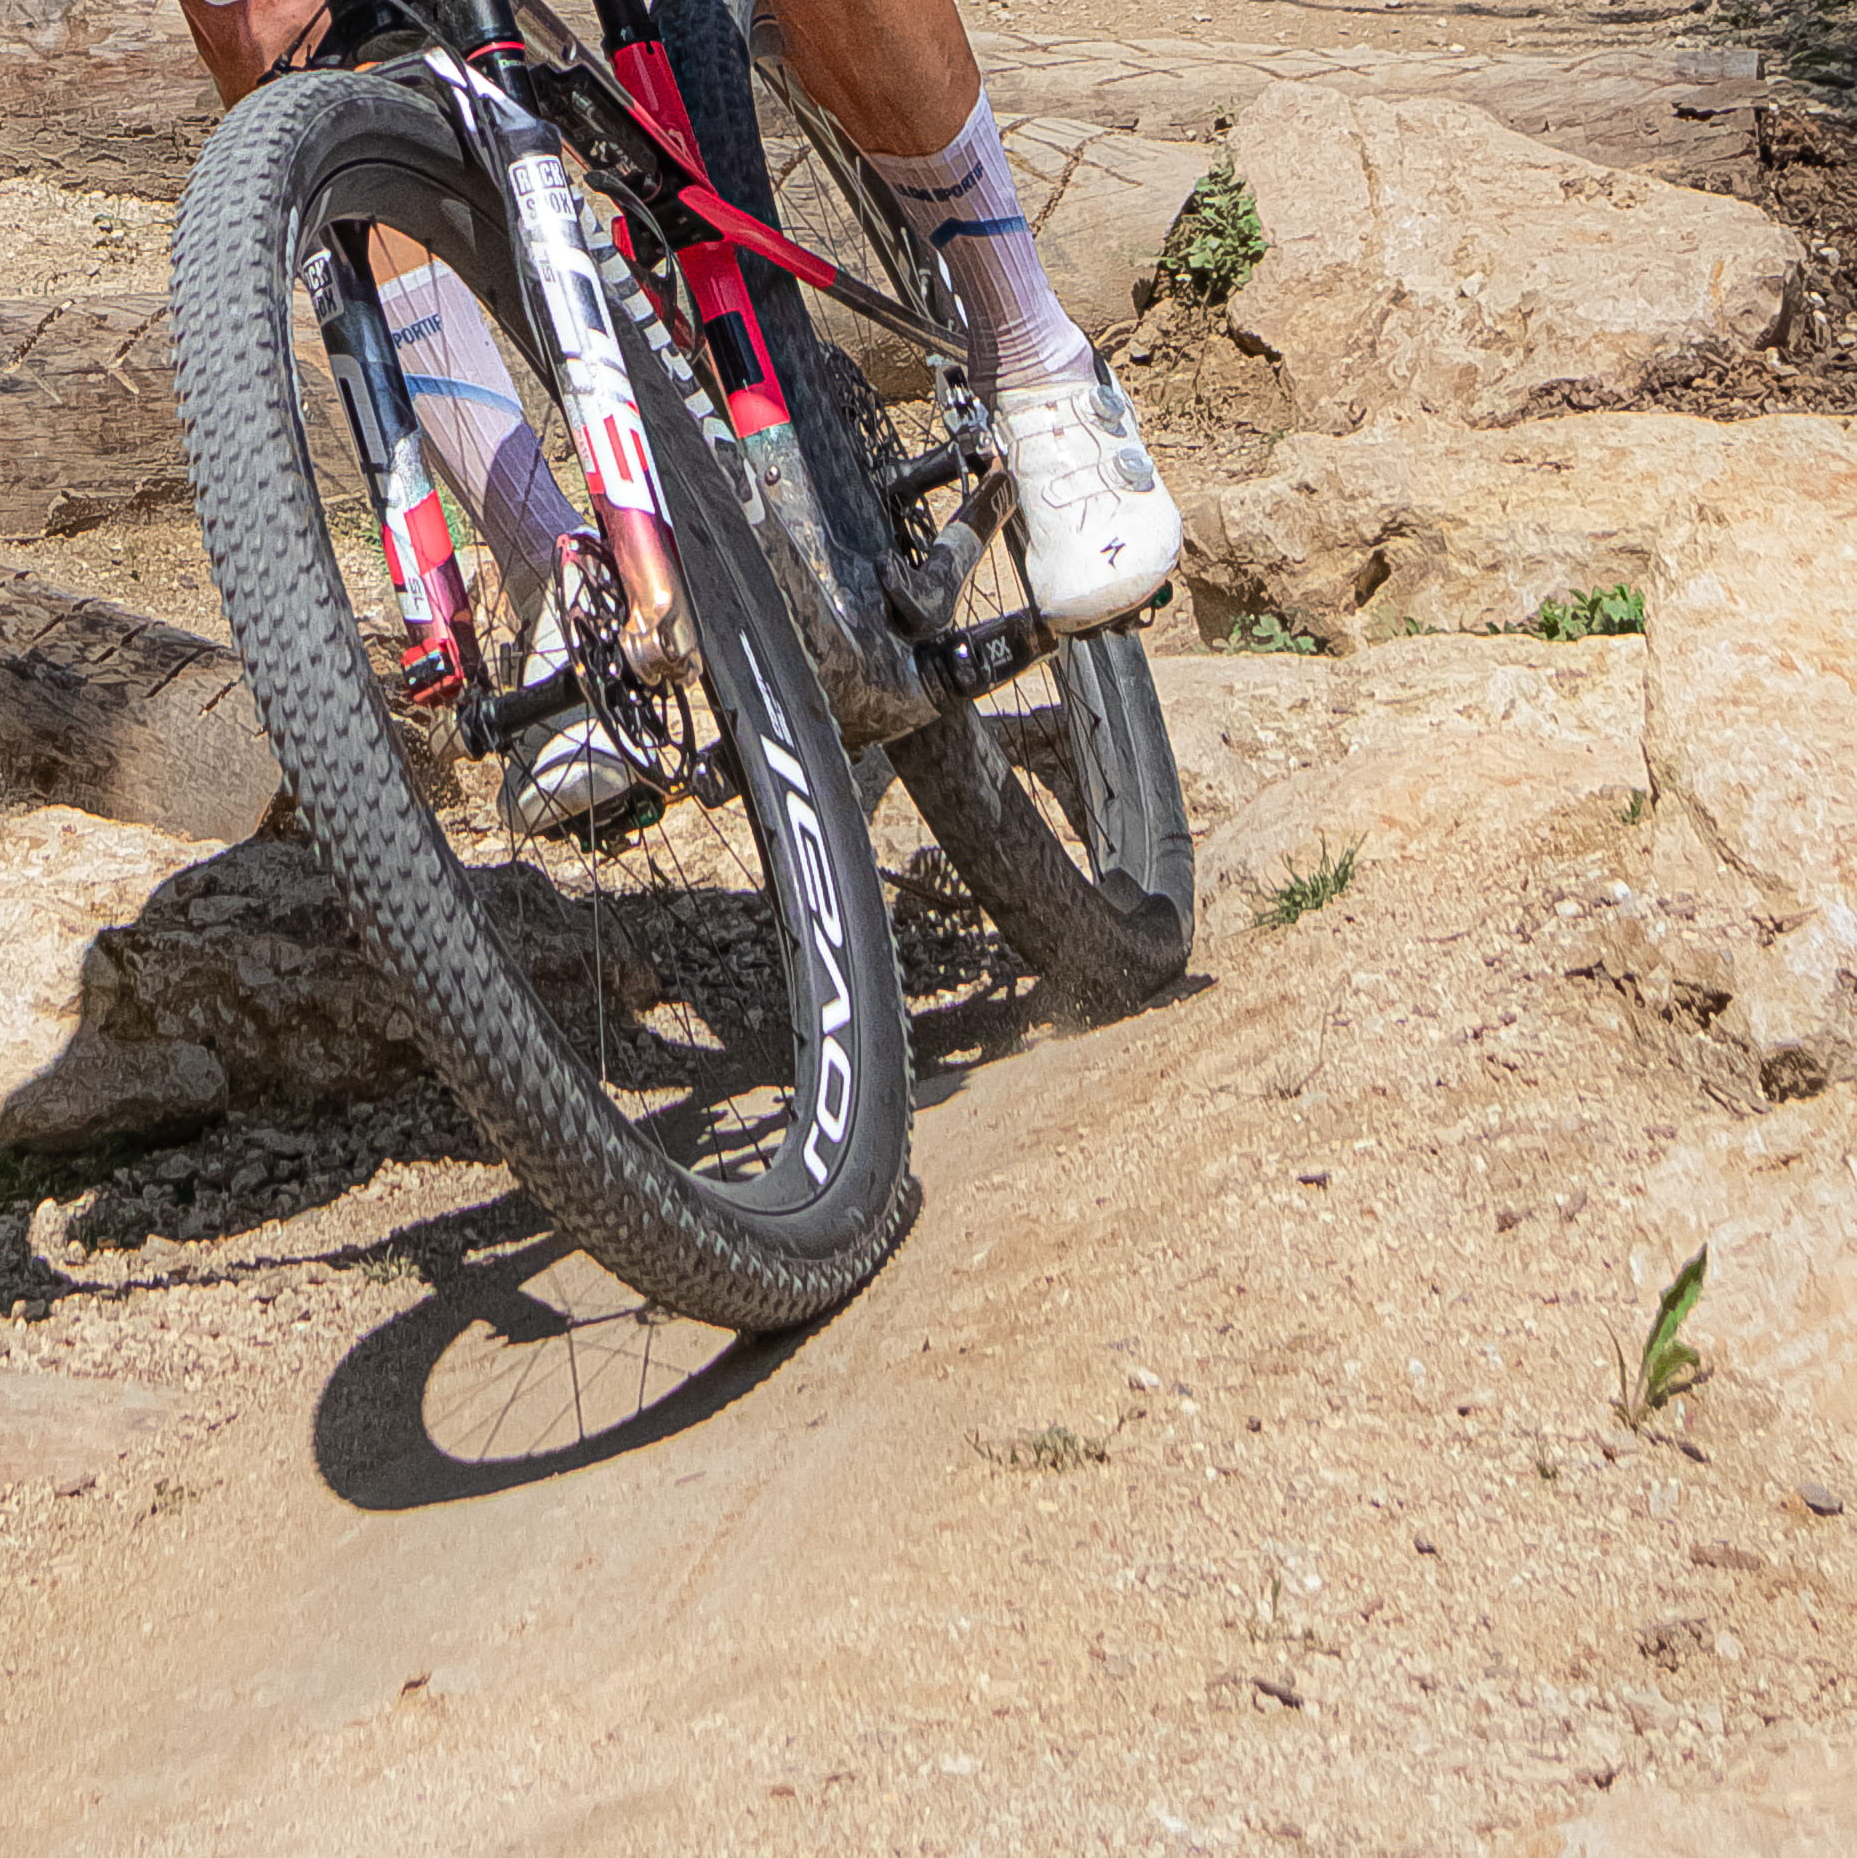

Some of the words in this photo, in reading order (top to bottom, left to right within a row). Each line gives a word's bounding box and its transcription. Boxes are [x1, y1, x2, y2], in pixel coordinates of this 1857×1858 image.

[513, 160, 566, 196] RCK
[526, 191, 574, 220] SOX
[391, 312, 443, 350] PORTIF
